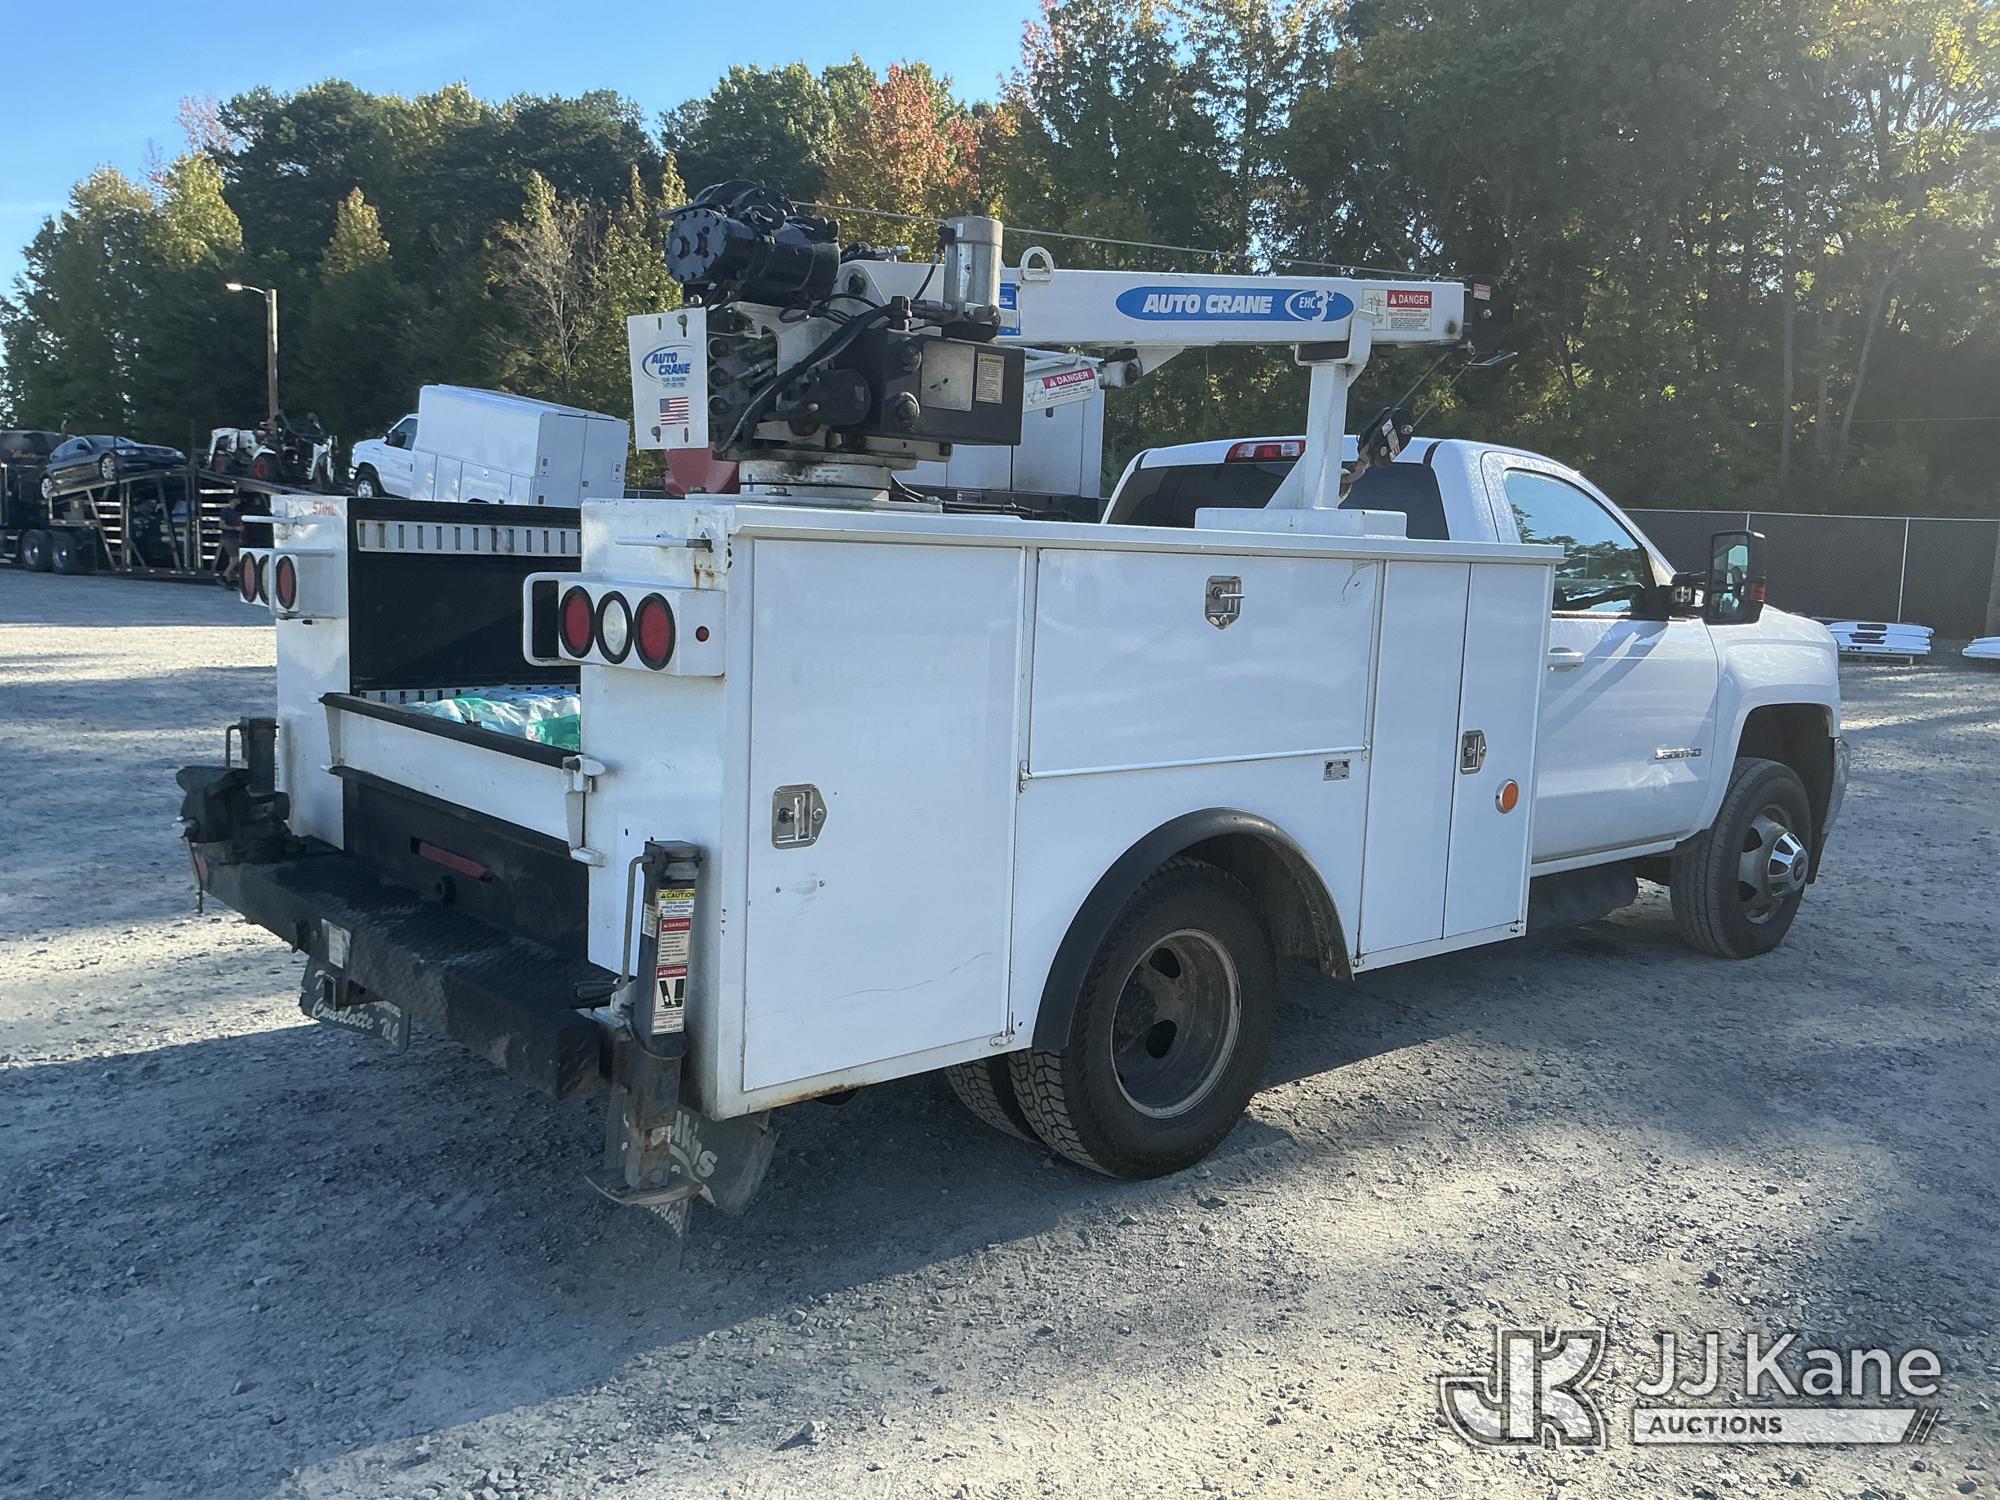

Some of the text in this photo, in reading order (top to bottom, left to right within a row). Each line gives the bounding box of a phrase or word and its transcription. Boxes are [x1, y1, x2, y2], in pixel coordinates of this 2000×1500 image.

[1142, 293, 1273, 315] AUTO CRANE
[1398, 294, 1430, 305] DANGER
[650, 352, 678, 364] AUTO
[658, 363, 691, 376] CRANE
[1056, 370, 1090, 386] DANGER
[666, 891, 696, 900] CAUTION
[667, 921, 689, 929] DANGER
[663, 967, 687, 976] DANGER
